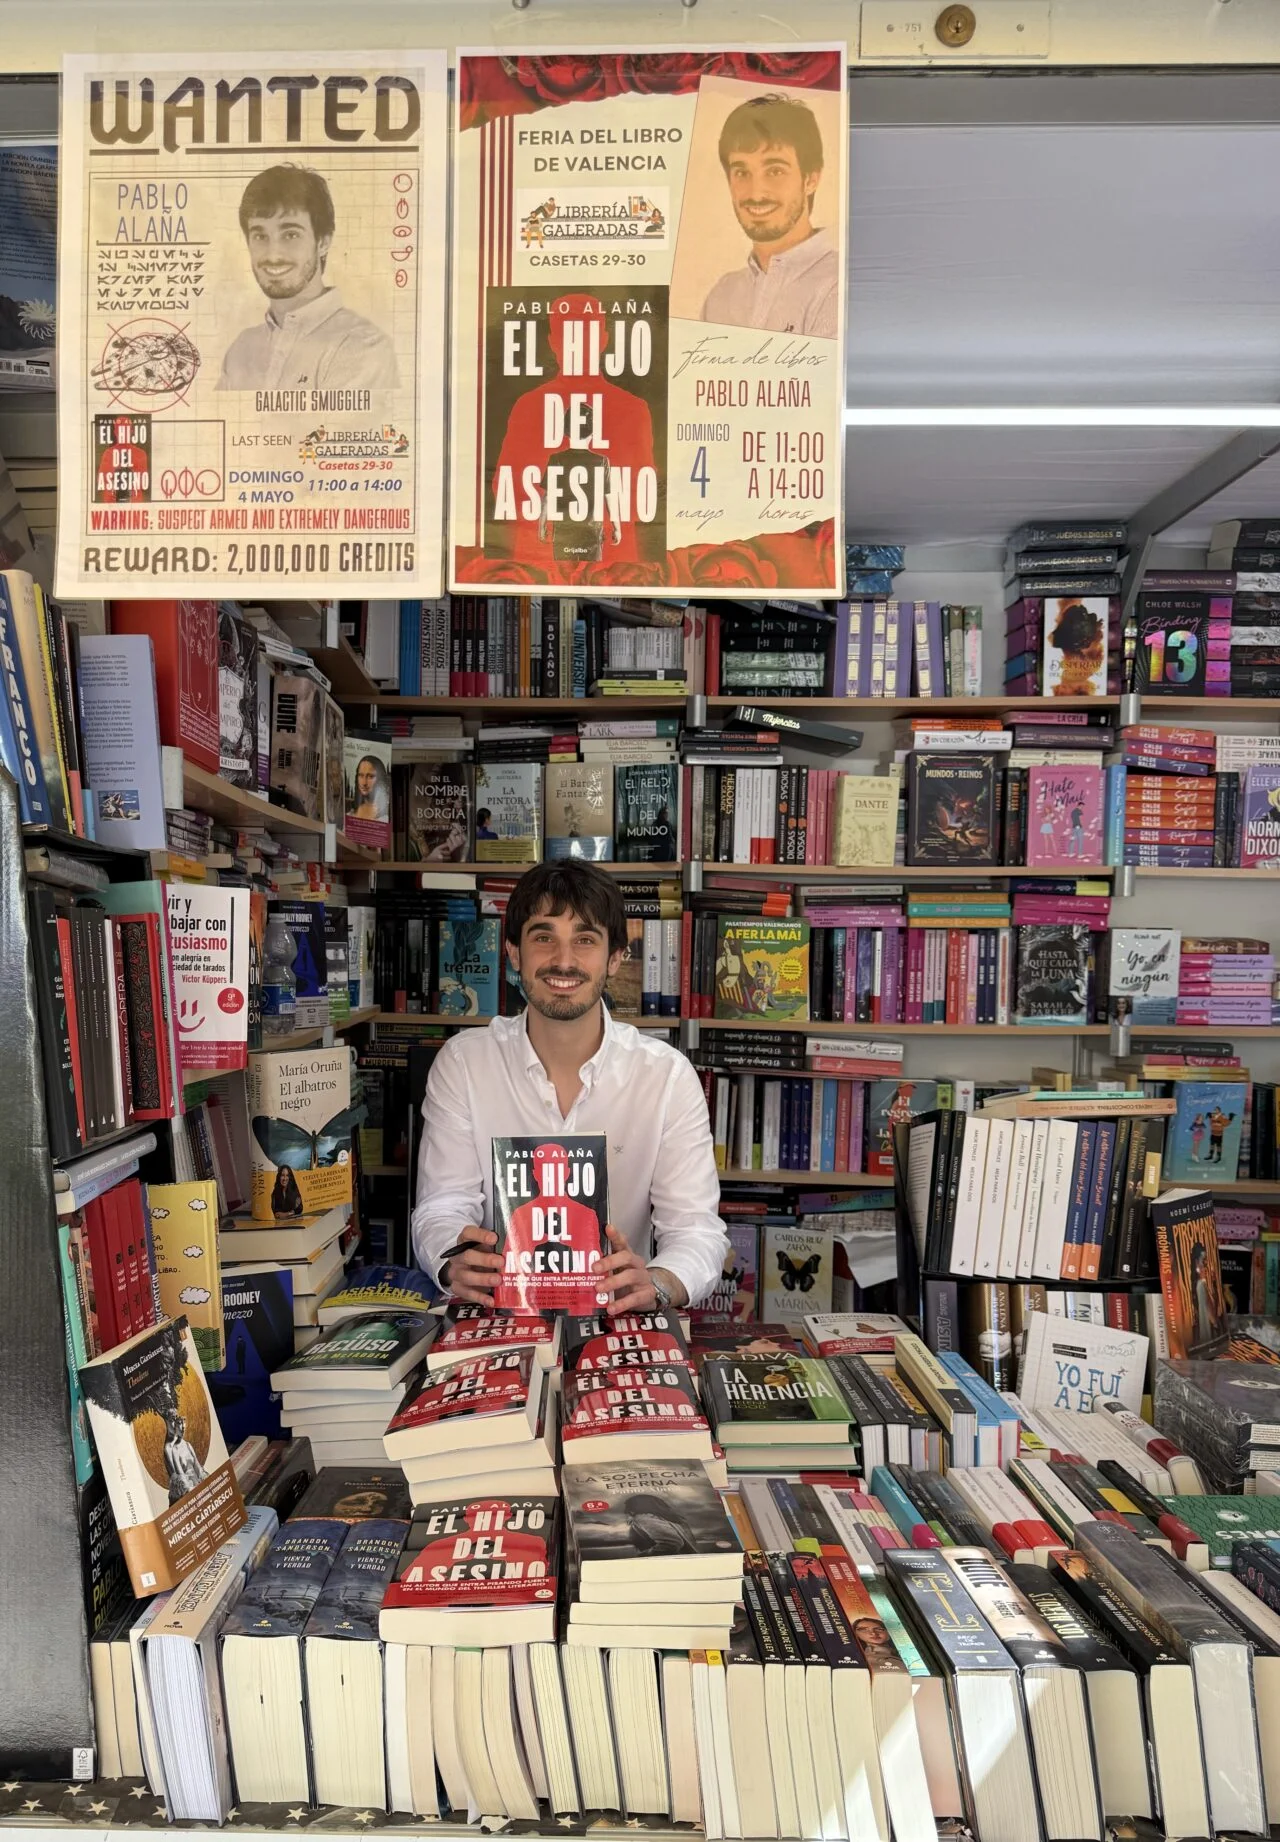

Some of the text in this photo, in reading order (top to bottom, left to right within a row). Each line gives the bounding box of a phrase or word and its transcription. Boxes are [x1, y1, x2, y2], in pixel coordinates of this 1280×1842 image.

[90, 74, 421, 153] WANTED
[518, 127, 683, 145] FERIA DEL LIBRO
[534, 155, 667, 172] DE VALENCIA
[117, 183, 188, 210] PABLO
[556, 203, 629, 219] LIBRERÍA
[116, 209, 188, 242] ALAÑA
[542, 222, 639, 237] GALERADAS
[529, 254, 646, 267] CASETAS 29-30
[503, 298, 653, 315] PABLO ALAÑA
[503, 320, 652, 377] EL HIJO
[672, 336, 829, 379] Firma de libros
[256, 390, 370, 412] GALACTIC SMUGGLER
[695, 377, 812, 408] PABLO ALAÑA
[543, 393, 610, 450] DEL
[99, 425, 147, 444] EL HIJO
[232, 435, 292, 446] LAST SEEN
[325, 429, 382, 443] LIBRERÍA
[676, 423, 730, 442] DOMINGO
[315, 445, 389, 456] GALERADAS
[742, 431, 824, 464] DE 11:00
[112, 449, 134, 467] DEL
[318, 460, 393, 471] Casetas 29-30
[97, 472, 149, 490] ASESINO
[229, 471, 304, 484] DOMINGO
[690, 446, 711, 499] 4
[308, 479, 402, 491] 11:00 a 14:00
[748, 468, 824, 500] A 14:00
[238, 491, 294, 503] 4 MAYO
[493, 465, 658, 523] ASESINO
[758, 499, 815, 521] horas
[91, 508, 410, 530] WARNING: SUSPECT ARMED AND EXTREMELY DANGEROUS
[675, 507, 724, 532] mayo
[84, 543, 415, 576] REWARD: 2,000,000 CREDITS
[1145, 601, 1202, 609] CHLOE WALSH
[422, 609, 431, 670] MONSTRUOS
[1144, 629, 1198, 683] 13
[926, 770, 983, 779] MUNDOS REINOS
[415, 785, 468, 797] NOMBRE
[502, 786, 515, 796] LA
[625, 779, 637, 789] EL
[780, 771, 789, 800] DIOSAS
[1040, 777, 1076, 800] Hate
[486, 796, 531, 806] PINTORA
[726, 774, 735, 815] HERODES
[855, 799, 889, 809] DANTE
[417, 807, 466, 820] BORGIA
[640, 810, 657, 820] DEL
[627, 825, 668, 837] MUNDO
[787, 830, 795, 860] DIOSAS
[797, 830, 806, 860] DIOSAS
[184, 898, 192, 914] y
[206, 917, 227, 932] con
[735, 930, 773, 940] FER LA
[204, 954, 211, 962] en
[465, 954, 481, 964] La
[1039, 950, 1068, 960] HASTA
[194, 963, 226, 973] de tarados
[444, 962, 490, 975] trenza
[1029, 959, 1078, 969] QUE CAIGA
[1041, 968, 1076, 980] LUNA
[1121, 973, 1170, 992] ningún
[279, 1059, 343, 1077] María Oruña
[280, 1079, 337, 1096] El albatros
[279, 1097, 311, 1113] negro
[505, 1147, 594, 1159] PABLO ALAÑA
[507, 1162, 596, 1198] EL HIJO
[1169, 1205, 1191, 1217] NOEMÍ
[532, 1206, 572, 1242] DEL
[774, 1233, 800, 1243] CARLOS
[1156, 1225, 1172, 1280] PIRÓMANAS
[223, 1290, 261, 1305] ROONEY
[774, 1297, 821, 1312] MARINA
[457, 1306, 481, 1319] EL
[477, 1317, 517, 1329] DEL
[580, 1315, 669, 1337] EL HIJO
[305, 1338, 399, 1355] RECLUSO
[607, 1335, 648, 1352] DEL
[421, 1354, 521, 1389] EL HIJO
[719, 1367, 749, 1384] LA
[1055, 1360, 1122, 1399] YO FUI
[442, 1375, 488, 1396] DEL
[577, 1372, 679, 1391] EL HIJO
[606, 1388, 656, 1404] DEL
[723, 1380, 833, 1401] HERENCIA
[1053, 1387, 1071, 1410] A
[600, 1471, 700, 1483] SOSPECHA
[605, 1479, 679, 1489] ETERNA
[430, 1501, 546, 1515] PABLO ALAÑA
[426, 1509, 546, 1536] EL HIJO
[168, 1521, 196, 1548] MIRCEA
[356, 1539, 400, 1548] BRANDON
[451, 1535, 508, 1560] DEL
[358, 1564, 386, 1572] VERDAD
[1053, 1622, 1090, 1640] LOS
